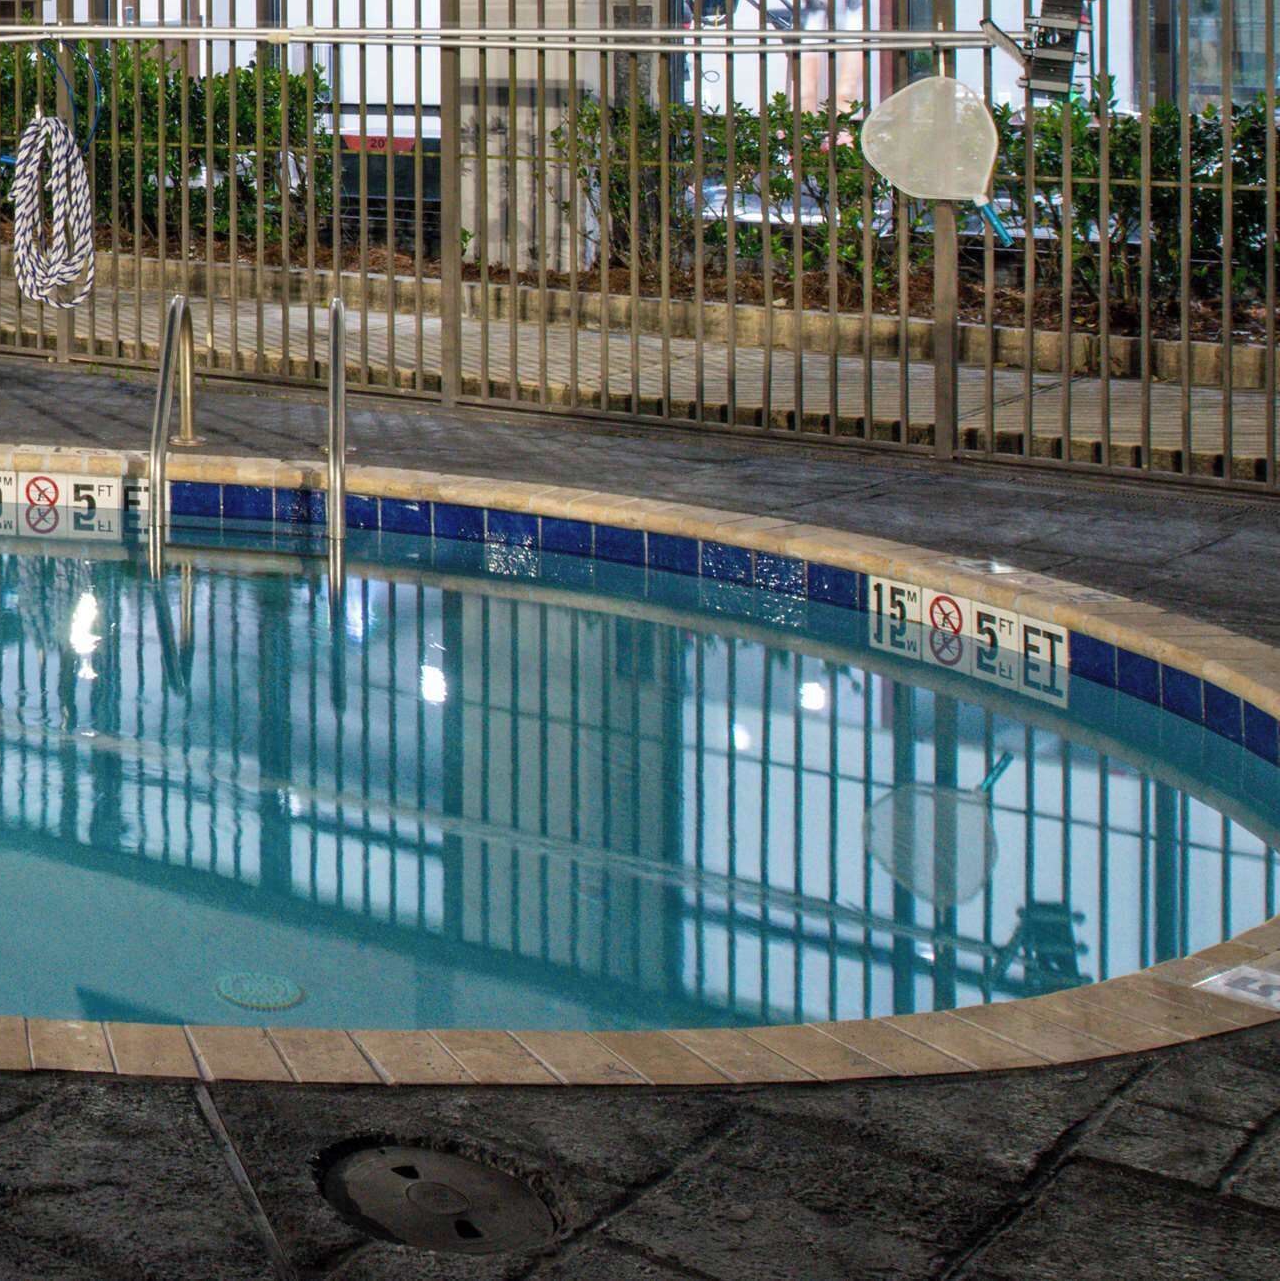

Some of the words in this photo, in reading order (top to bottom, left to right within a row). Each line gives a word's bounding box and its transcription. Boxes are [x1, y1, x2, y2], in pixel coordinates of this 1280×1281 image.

[3, 476, 12, 486] M
[73, 483, 96, 509] 5
[97, 485, 113, 497] FT
[907, 590, 917, 603] M
[976, 610, 999, 649] 5
[999, 617, 1014, 636] FT
[1023, 624, 1063, 667] FT
